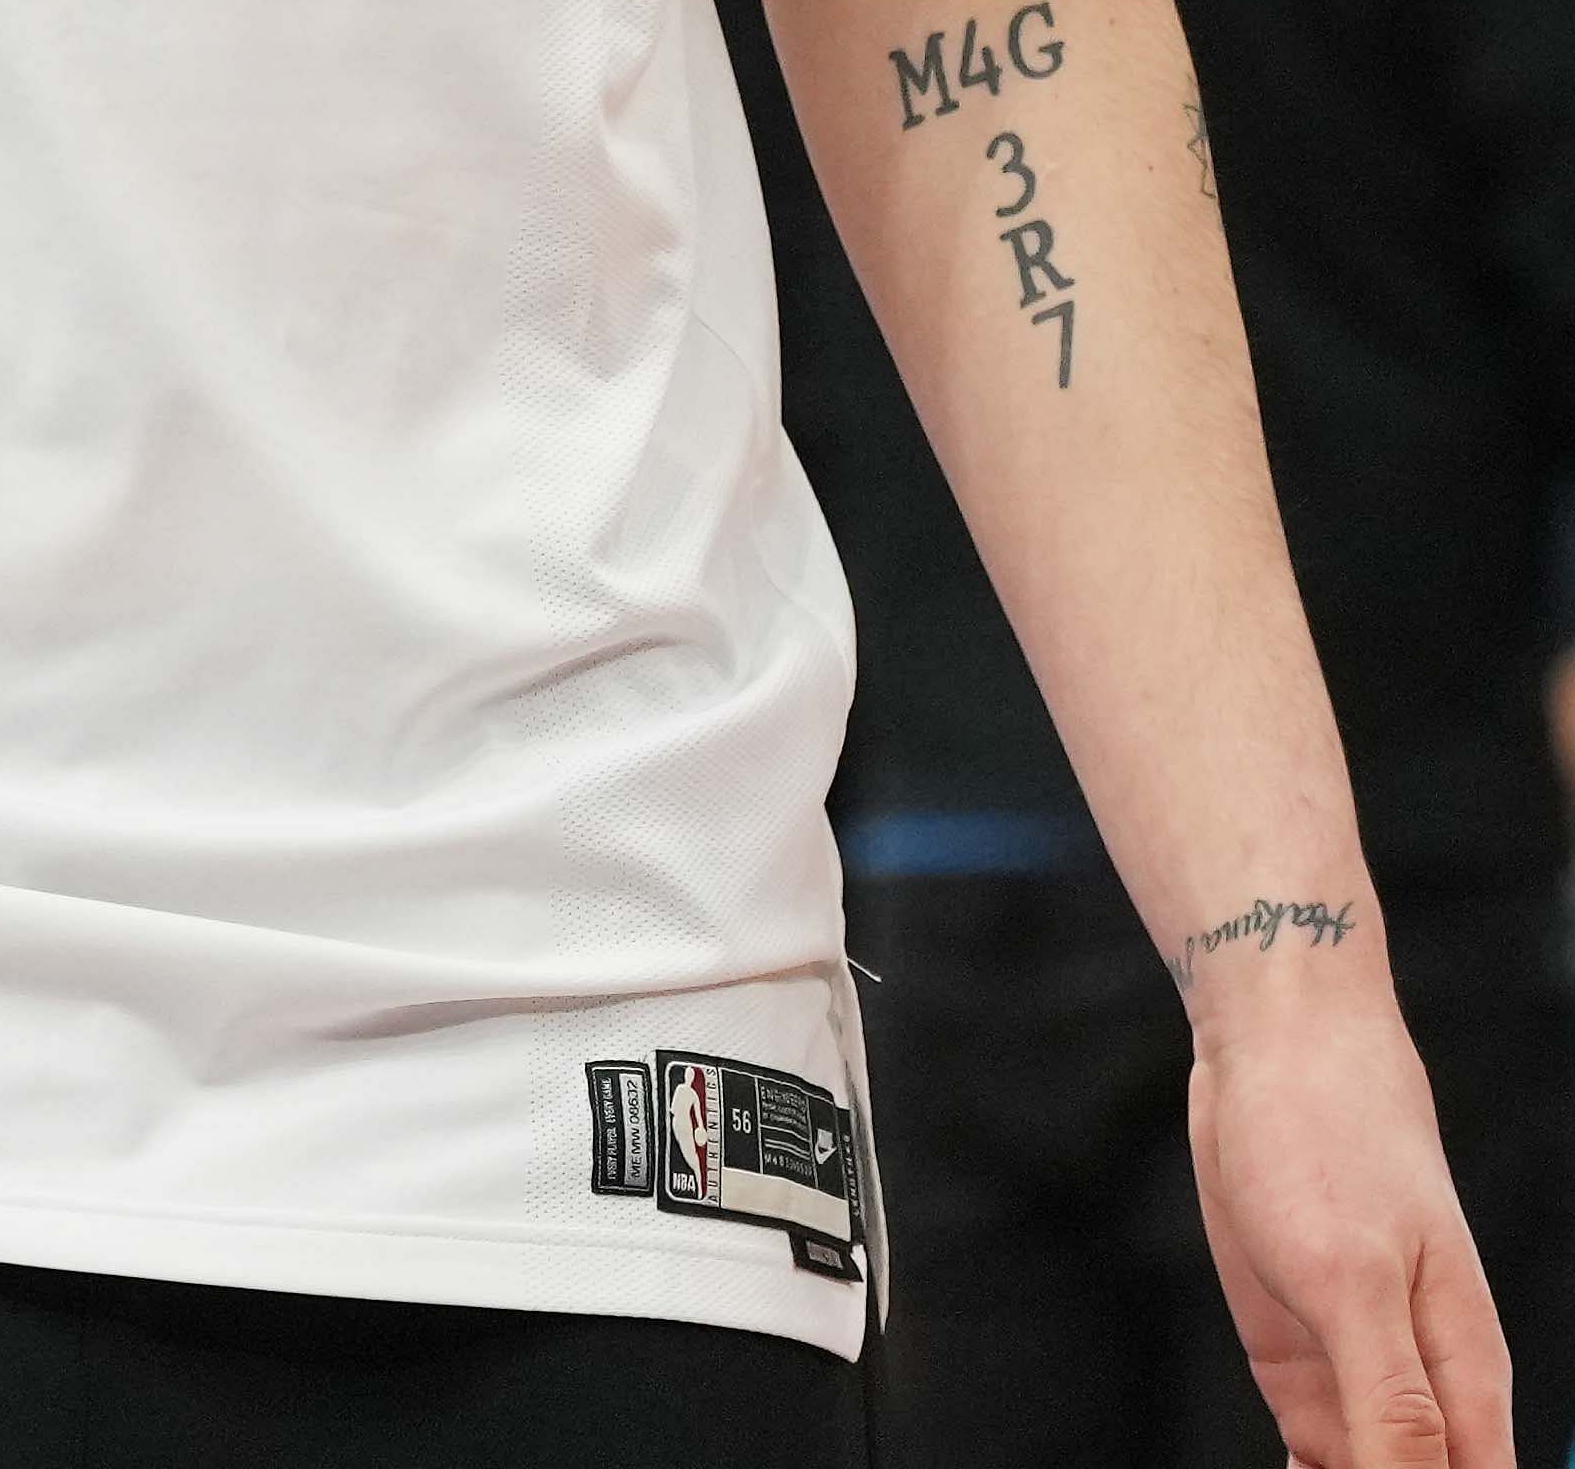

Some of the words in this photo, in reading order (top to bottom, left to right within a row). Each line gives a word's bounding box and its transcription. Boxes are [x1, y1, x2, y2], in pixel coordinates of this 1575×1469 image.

[888, 1, 1065, 131] M4G
[705, 1067, 719, 1203] AUTHENTICS
[731, 1107, 752, 1134] 56
[672, 1172, 696, 1193] NBA
